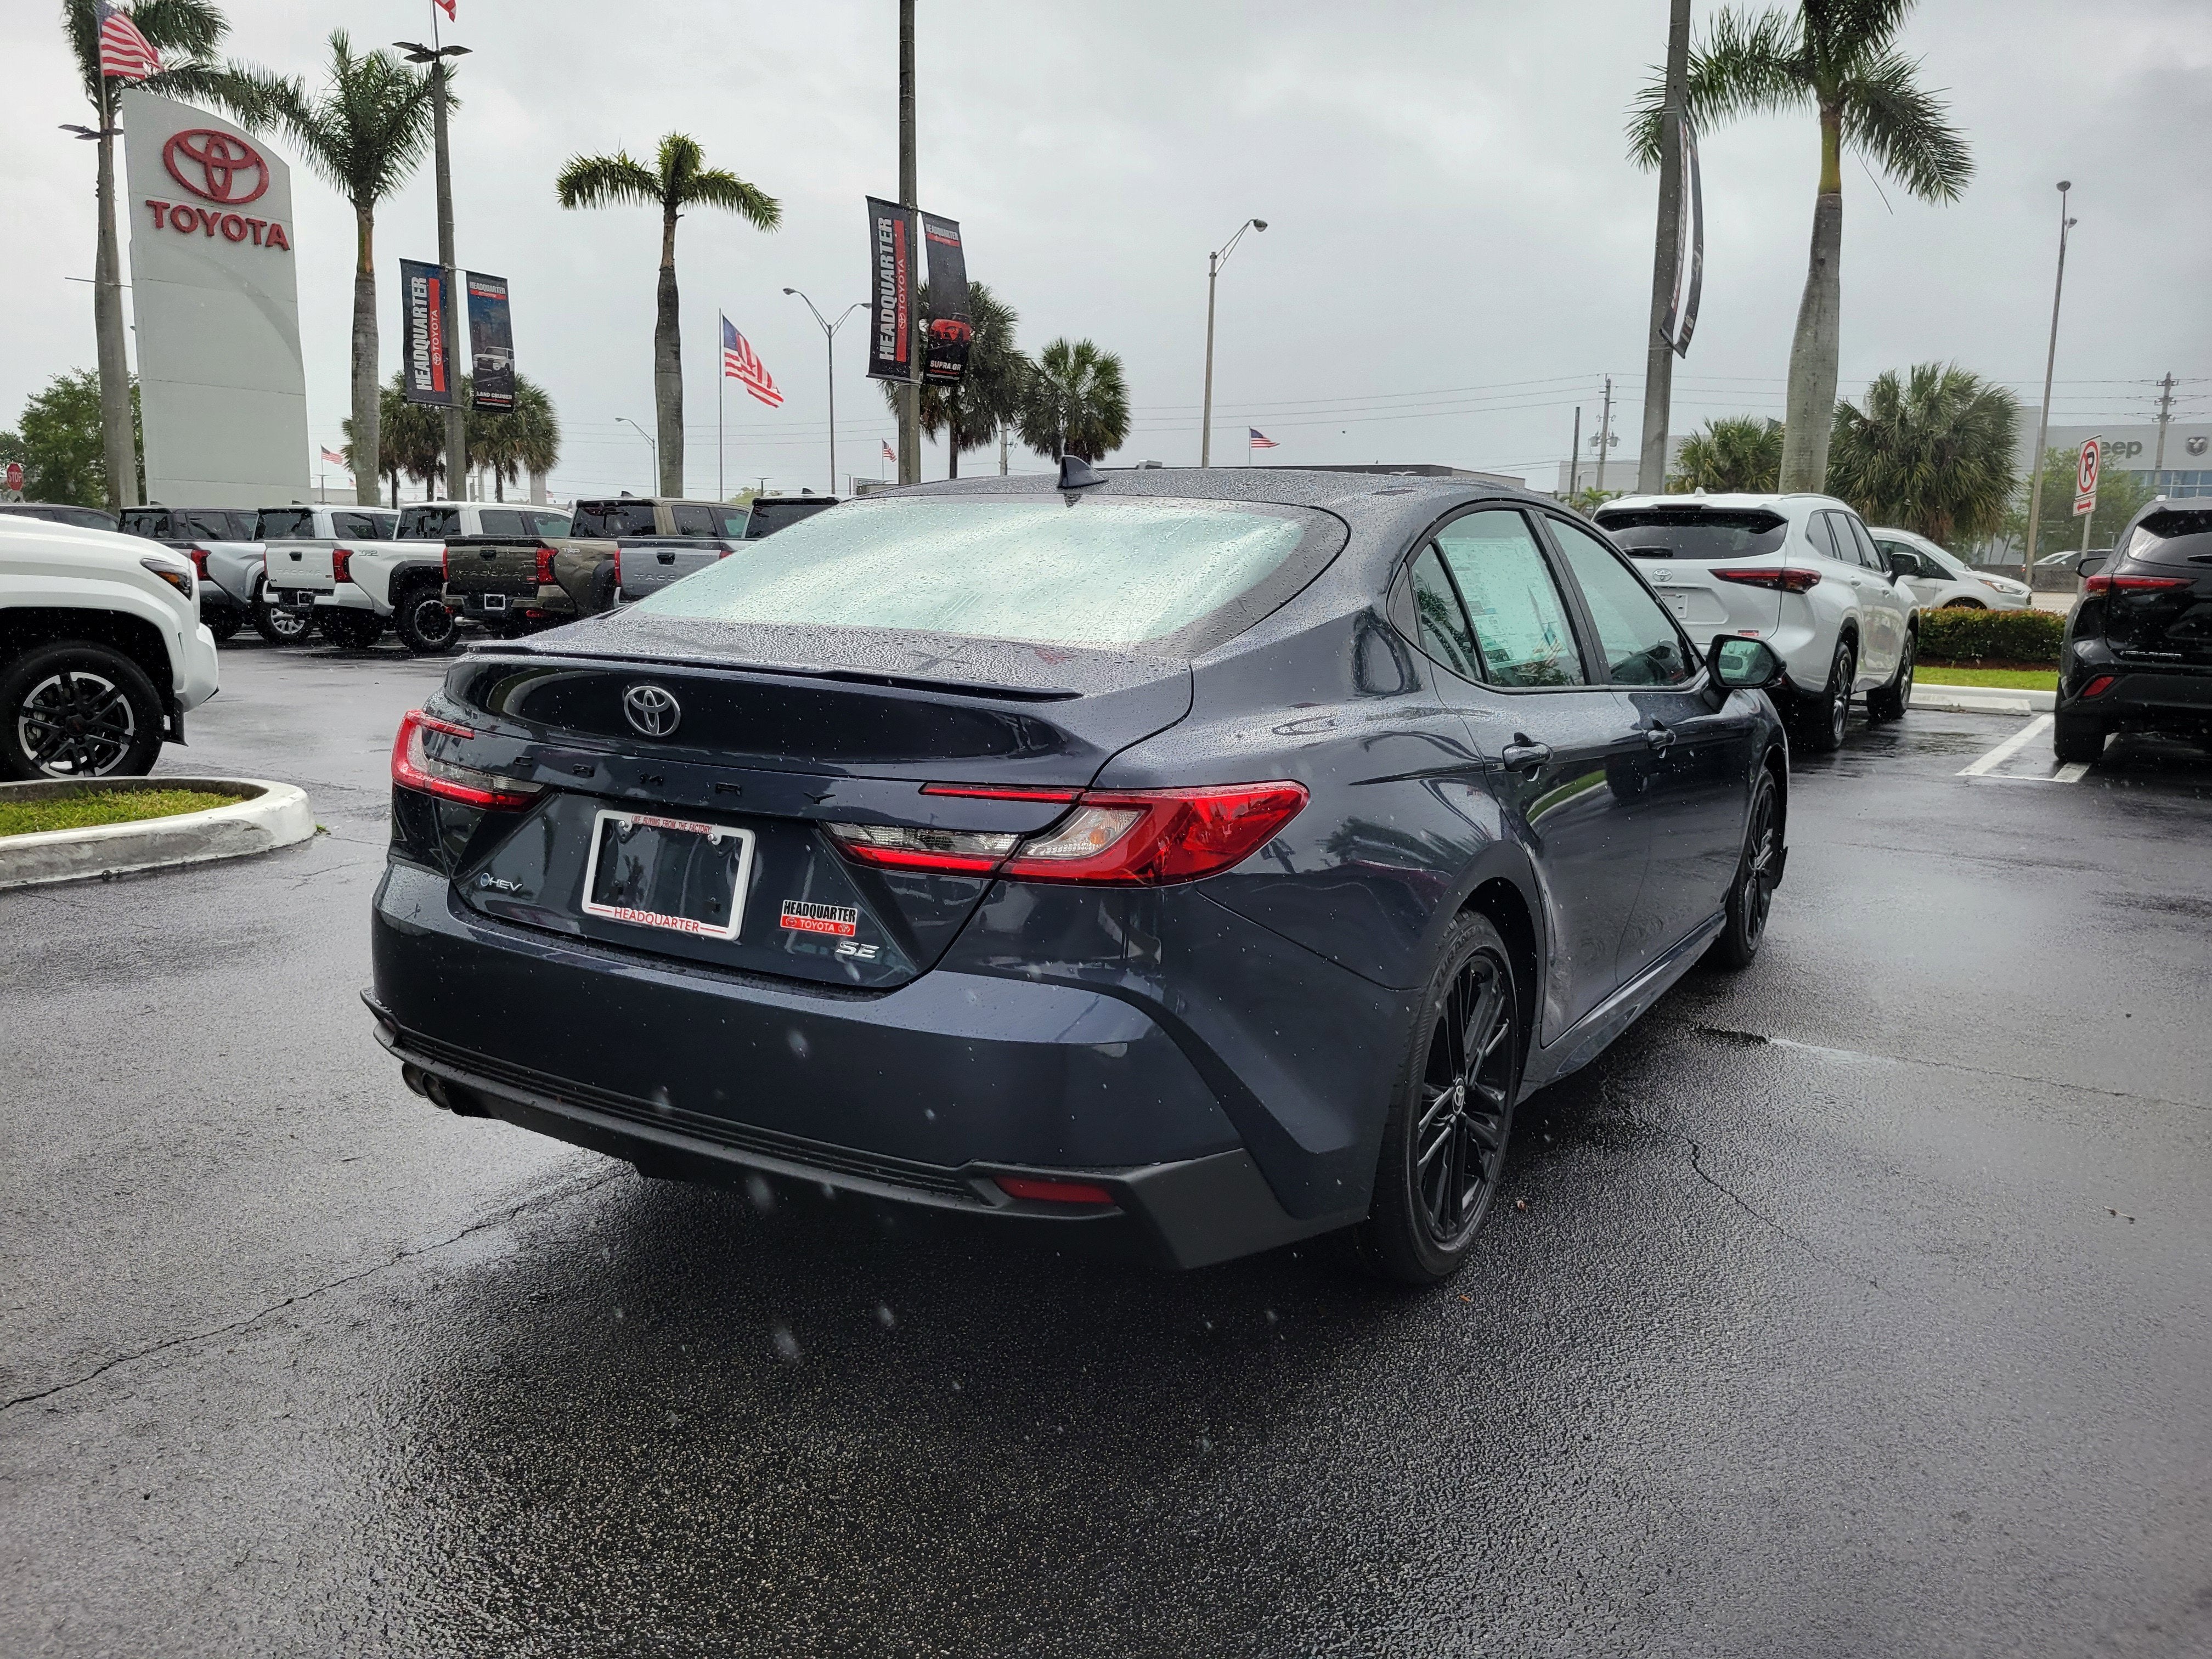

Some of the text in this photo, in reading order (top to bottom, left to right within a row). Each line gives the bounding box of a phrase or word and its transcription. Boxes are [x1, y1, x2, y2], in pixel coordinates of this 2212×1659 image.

[146, 199, 291, 251] TOYOTA
[470, 281, 506, 295] HEADQUARTER
[877, 217, 895, 362] HEADQUARTER
[896, 258, 905, 315] TOYOTA
[411, 276, 433, 391] HEADQUARTER
[431, 309, 440, 352] TOYOTA
[929, 360, 962, 371] SUPRA GR
[2101, 441, 2142, 459] eep
[8, 472, 22, 483] STOP
[631, 815, 713, 834] LIKE BUYING FROM THE FACTORY!
[489, 877, 523, 891] HEV
[614, 907, 699, 932] HEADQUARTER
[783, 900, 856, 923] HEADQUARTER
[800, 919, 835, 932] TOYOTA
[836, 941, 879, 959] SE
[1434, 925, 1482, 989] TURANZA
